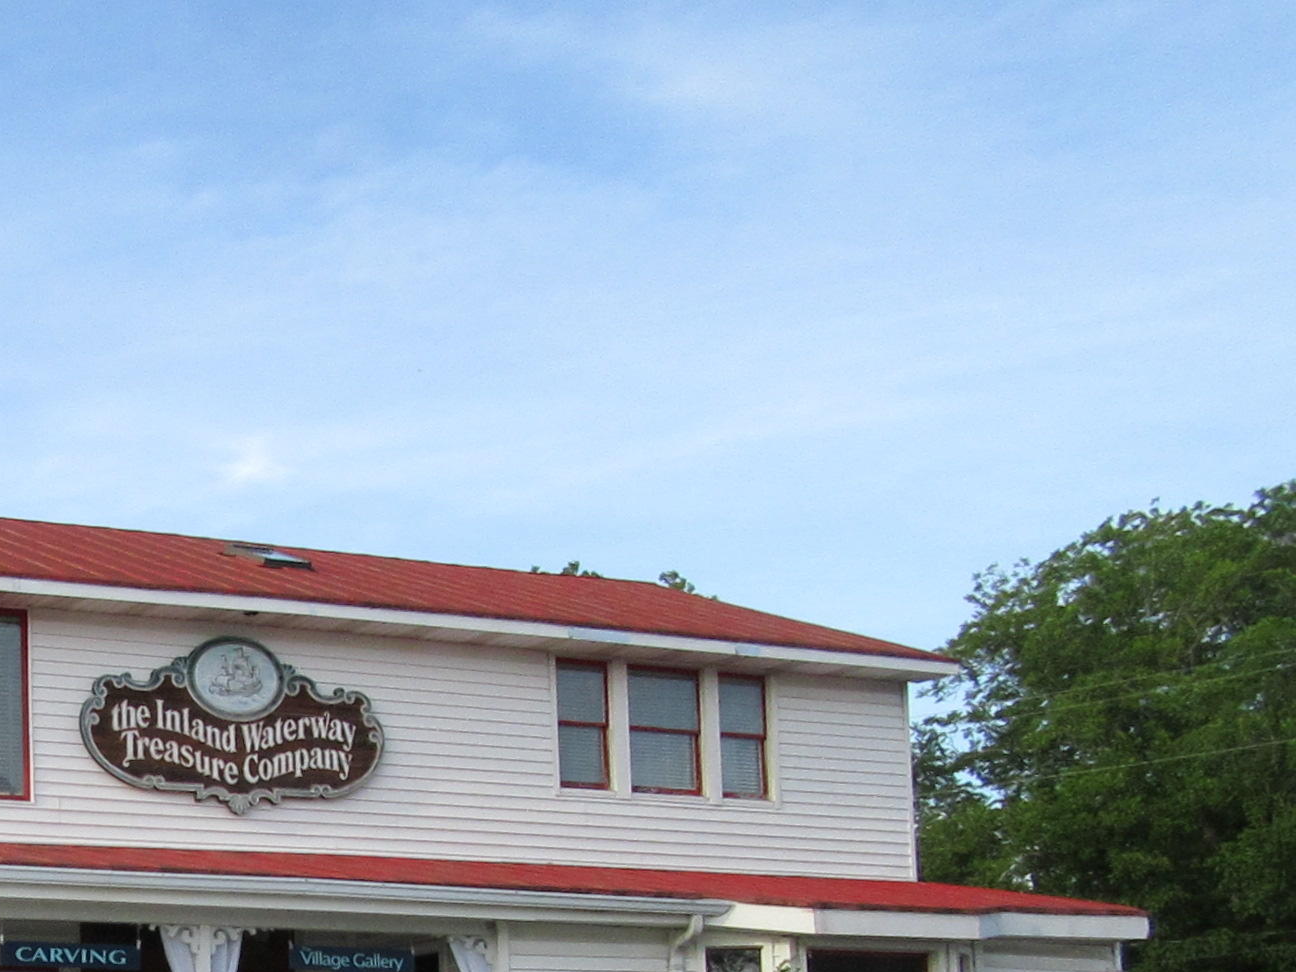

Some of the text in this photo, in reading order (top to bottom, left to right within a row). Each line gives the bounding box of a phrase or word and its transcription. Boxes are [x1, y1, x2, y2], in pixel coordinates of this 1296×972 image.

[112, 699, 356, 753] the Inland Waterway
[120, 729, 353, 785] Treasure Company
[15, 946, 127, 965] CARVING
[300, 950, 404, 972] Village Gallery
